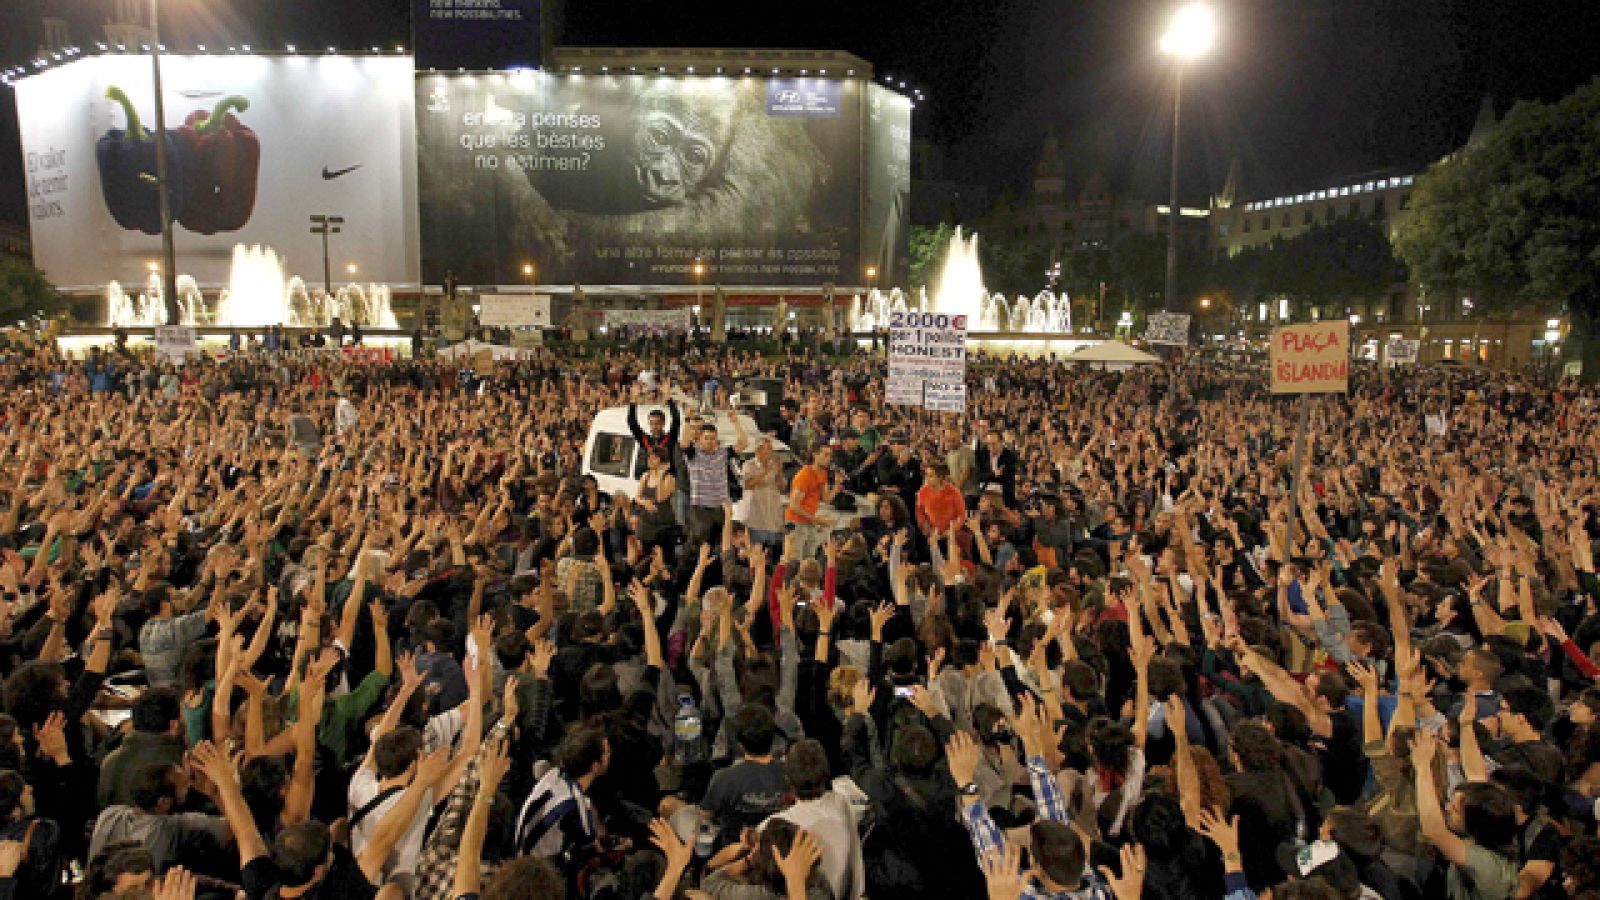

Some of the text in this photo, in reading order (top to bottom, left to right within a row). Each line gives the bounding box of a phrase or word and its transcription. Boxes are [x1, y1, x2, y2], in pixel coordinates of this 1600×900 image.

[531, 111, 601, 131] penses
[459, 132, 496, 151] que
[501, 130, 531, 149] les
[474, 152, 592, 171] no estimen?
[1281, 329, 1340, 353] PLAÇA
